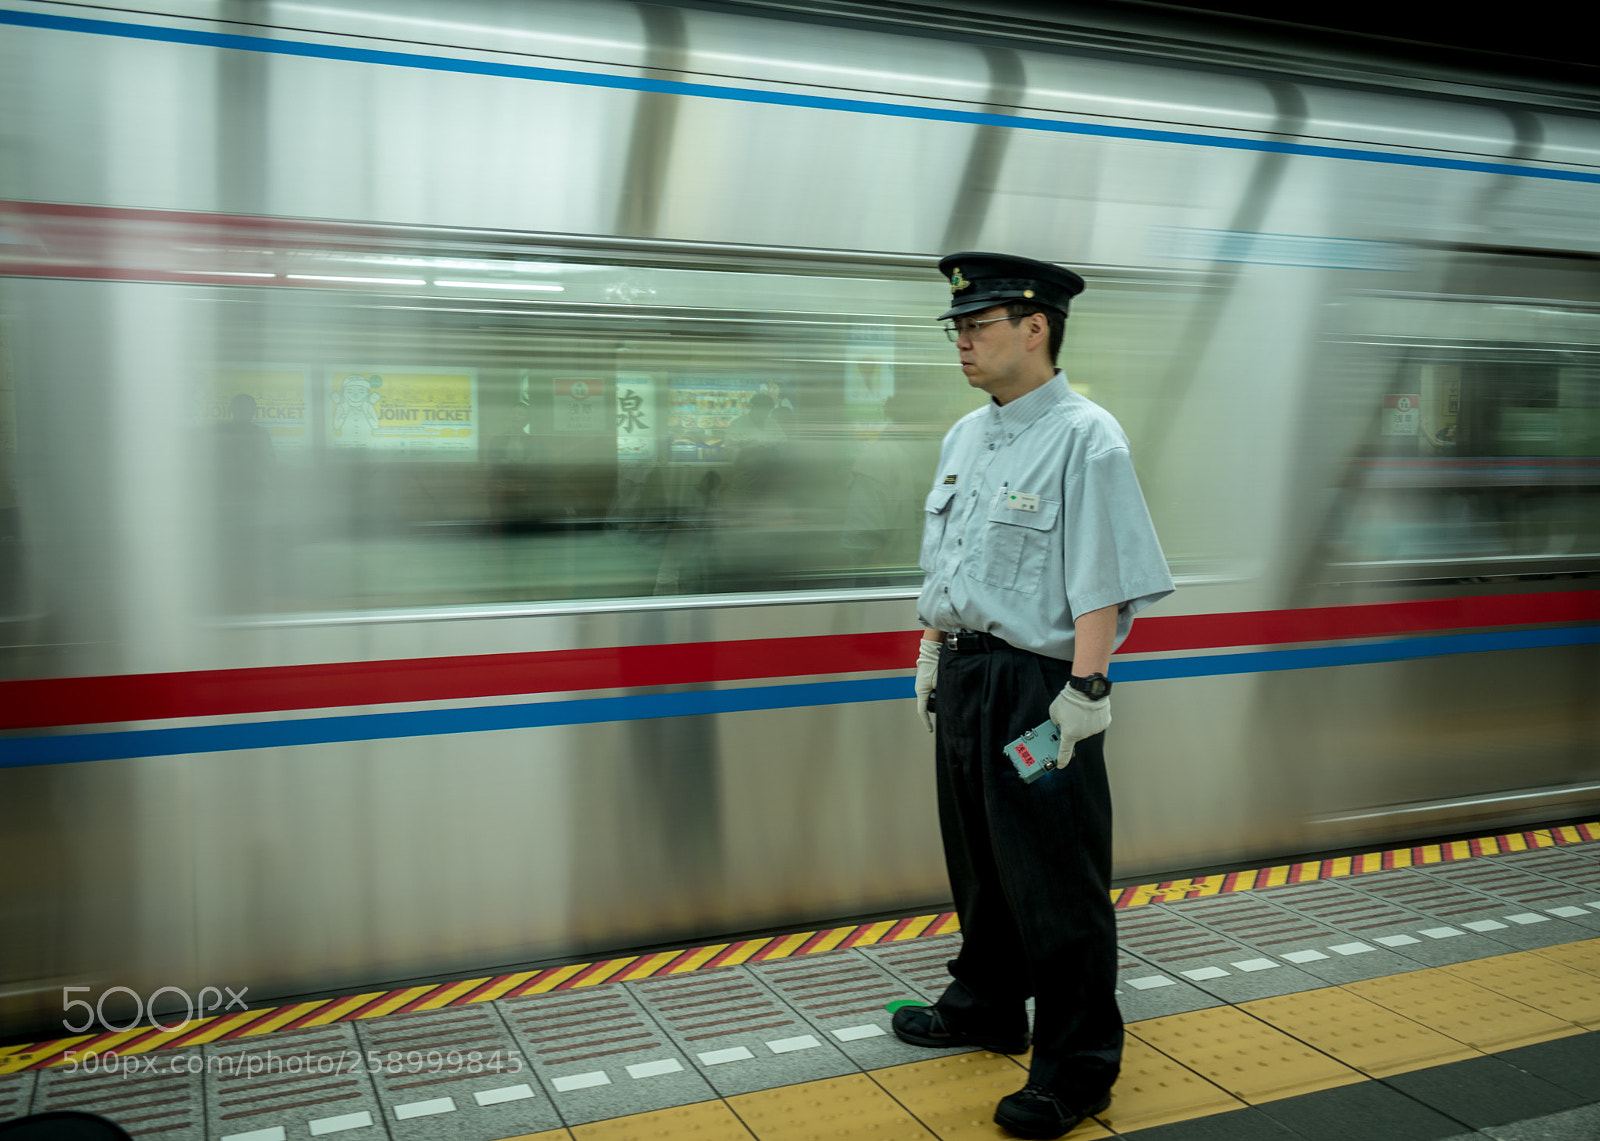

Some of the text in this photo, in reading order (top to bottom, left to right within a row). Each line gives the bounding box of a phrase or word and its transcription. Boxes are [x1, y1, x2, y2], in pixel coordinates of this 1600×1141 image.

[378, 408, 473, 421] JOINT TICKET
[616, 389, 650, 433] 泉
